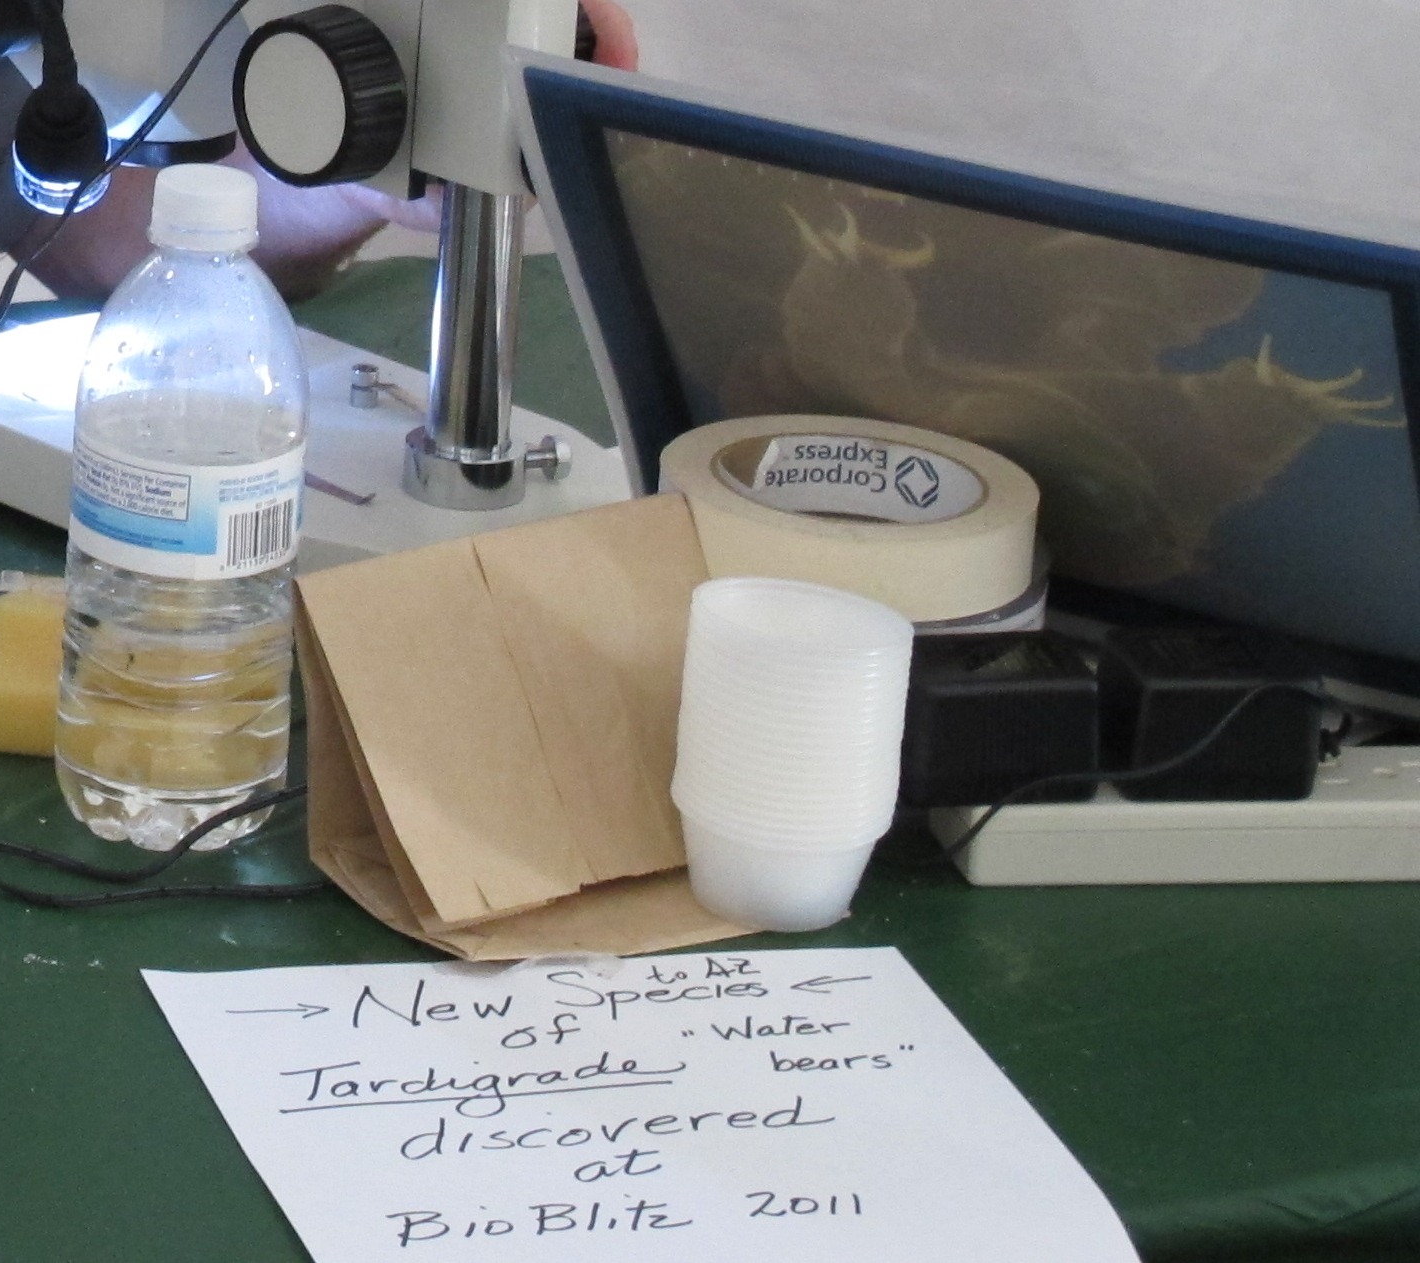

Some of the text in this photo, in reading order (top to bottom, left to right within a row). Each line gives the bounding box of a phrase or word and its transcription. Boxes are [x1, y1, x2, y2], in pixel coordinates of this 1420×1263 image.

[794, 442, 888, 470] Express
[764, 463, 887, 493] Corporate
[646, 956, 761, 985] to AZ
[352, 970, 769, 1028] New Species
[500, 1012, 581, 1049] of
[279, 1050, 687, 1119] Tardigrade
[400, 1095, 836, 1160] discovered
[573, 1147, 664, 1183] at
[746, 1191, 863, 1218] 2011
